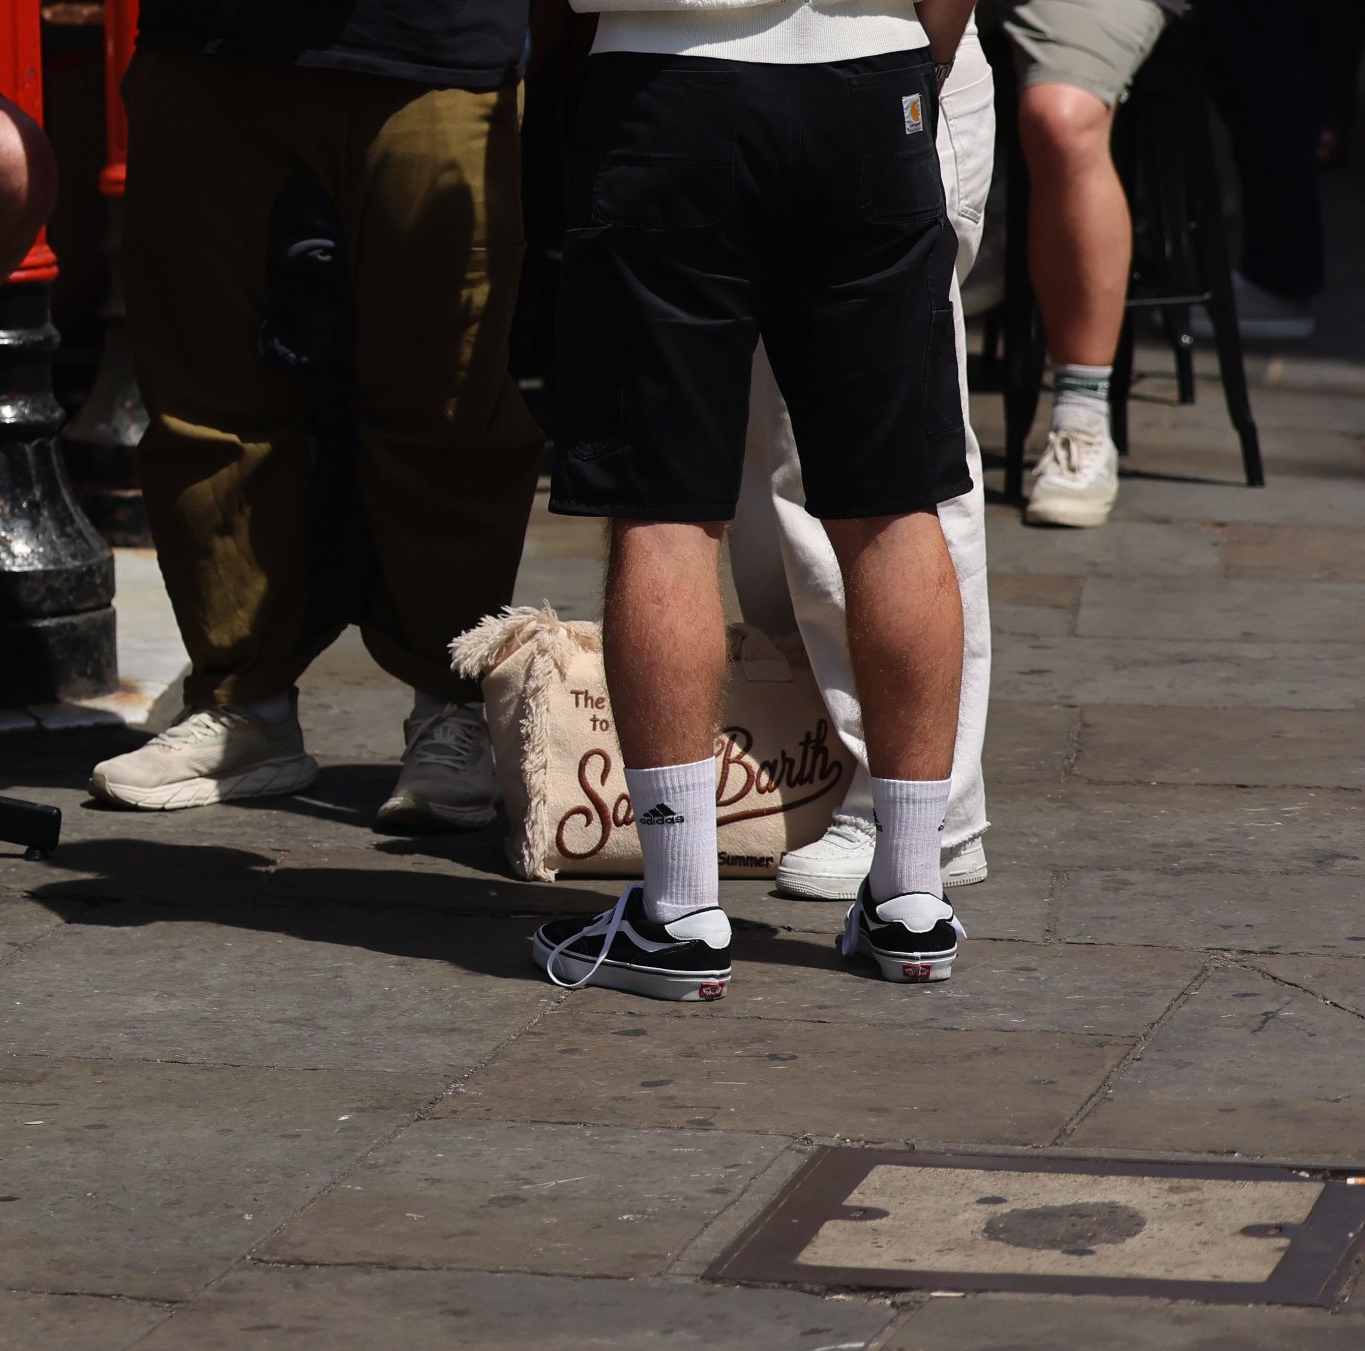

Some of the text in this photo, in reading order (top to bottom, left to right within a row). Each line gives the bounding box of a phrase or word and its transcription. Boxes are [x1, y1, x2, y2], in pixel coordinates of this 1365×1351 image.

[570, 689, 606, 710] The
[589, 714, 610, 732] to
[555, 718, 843, 860] Sa Barth
[639, 815, 685, 826] adidas
[718, 851, 774, 868] Summer
